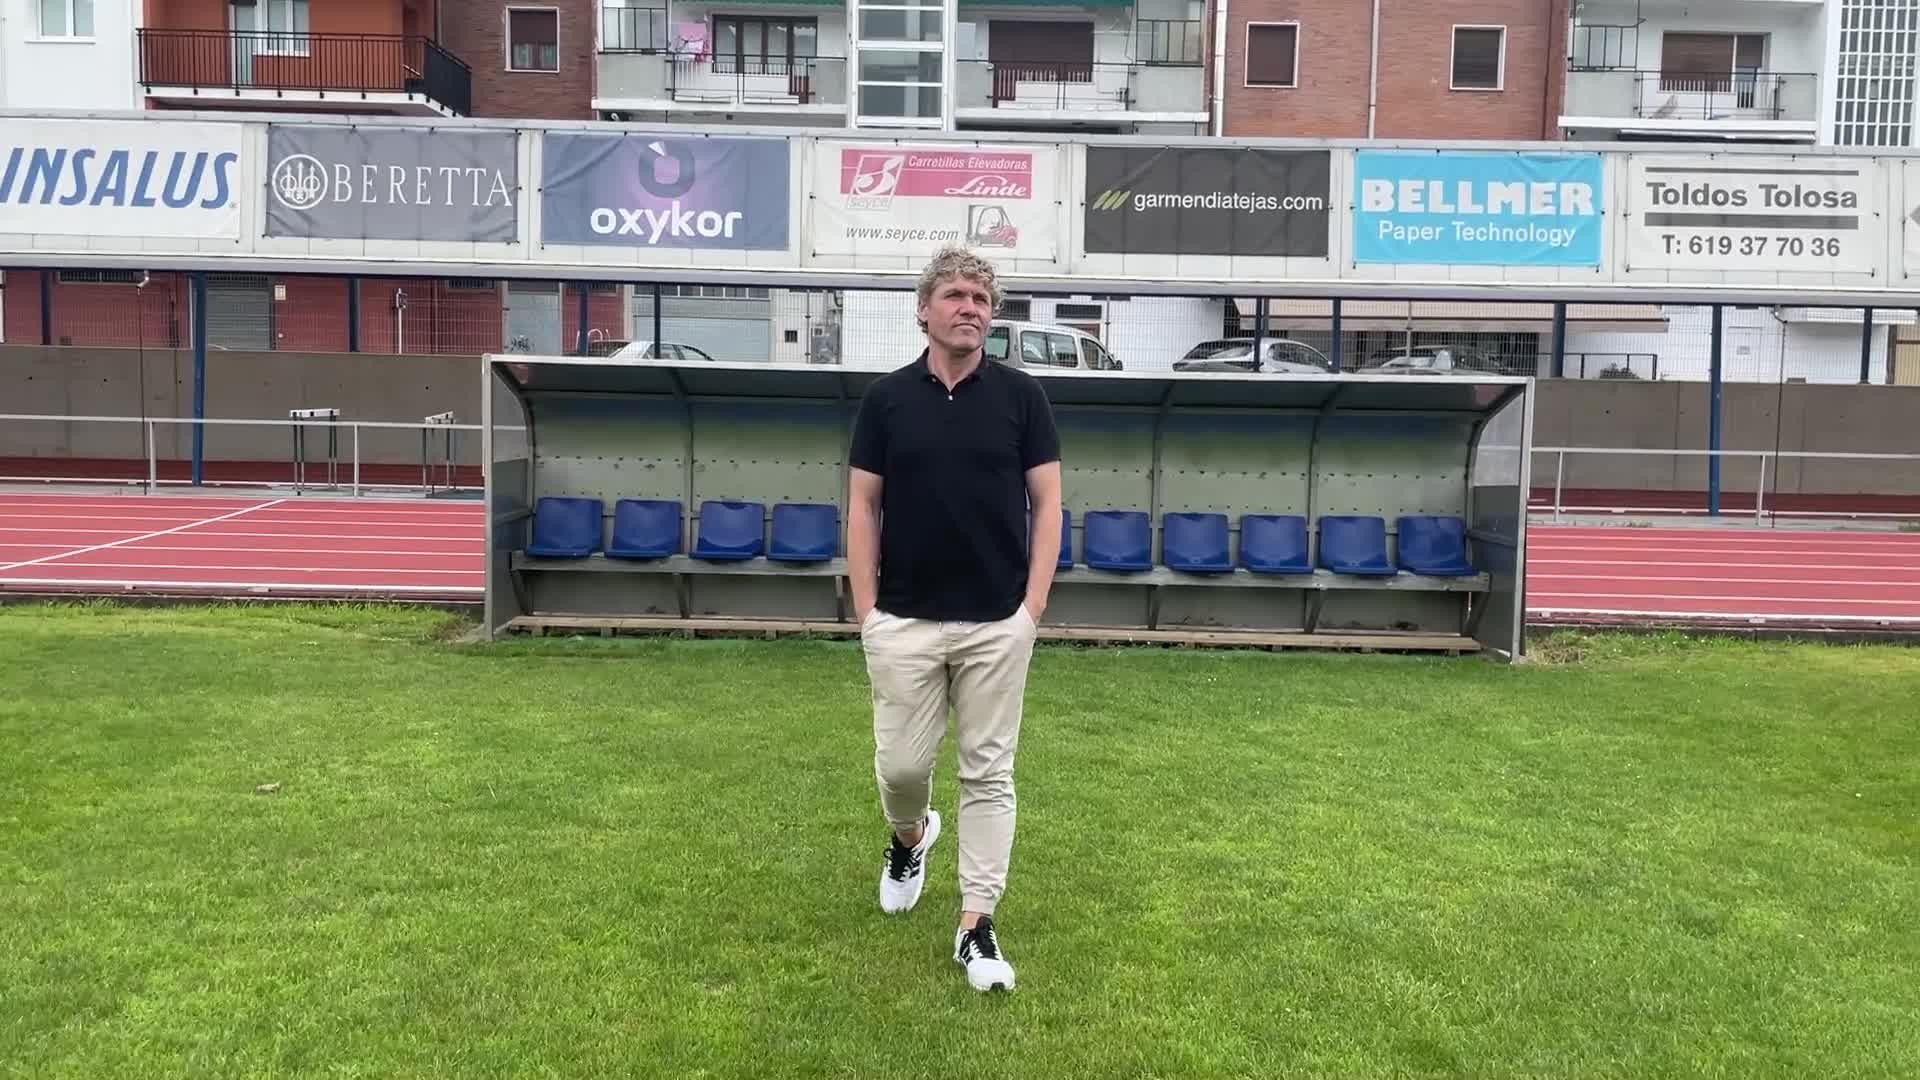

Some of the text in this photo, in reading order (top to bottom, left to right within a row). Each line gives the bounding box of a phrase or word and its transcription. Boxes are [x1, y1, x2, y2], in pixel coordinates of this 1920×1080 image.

[967, 157, 1027, 170] Elevadoras
[0, 147, 238, 209] INSALUS
[333, 163, 512, 207] BERETTA
[944, 174, 1027, 197] Linde
[1134, 192, 1323, 214] garmendiatejas.com
[1361, 178, 1594, 216] BELLMER
[1645, 182, 1858, 208] Toldos Tolosa
[590, 200, 743, 244] oxykor
[845, 226, 959, 241] www.seyce.com
[1379, 220, 1576, 247] Paper Technology
[1662, 234, 1840, 256] T: 619 37 70 36
